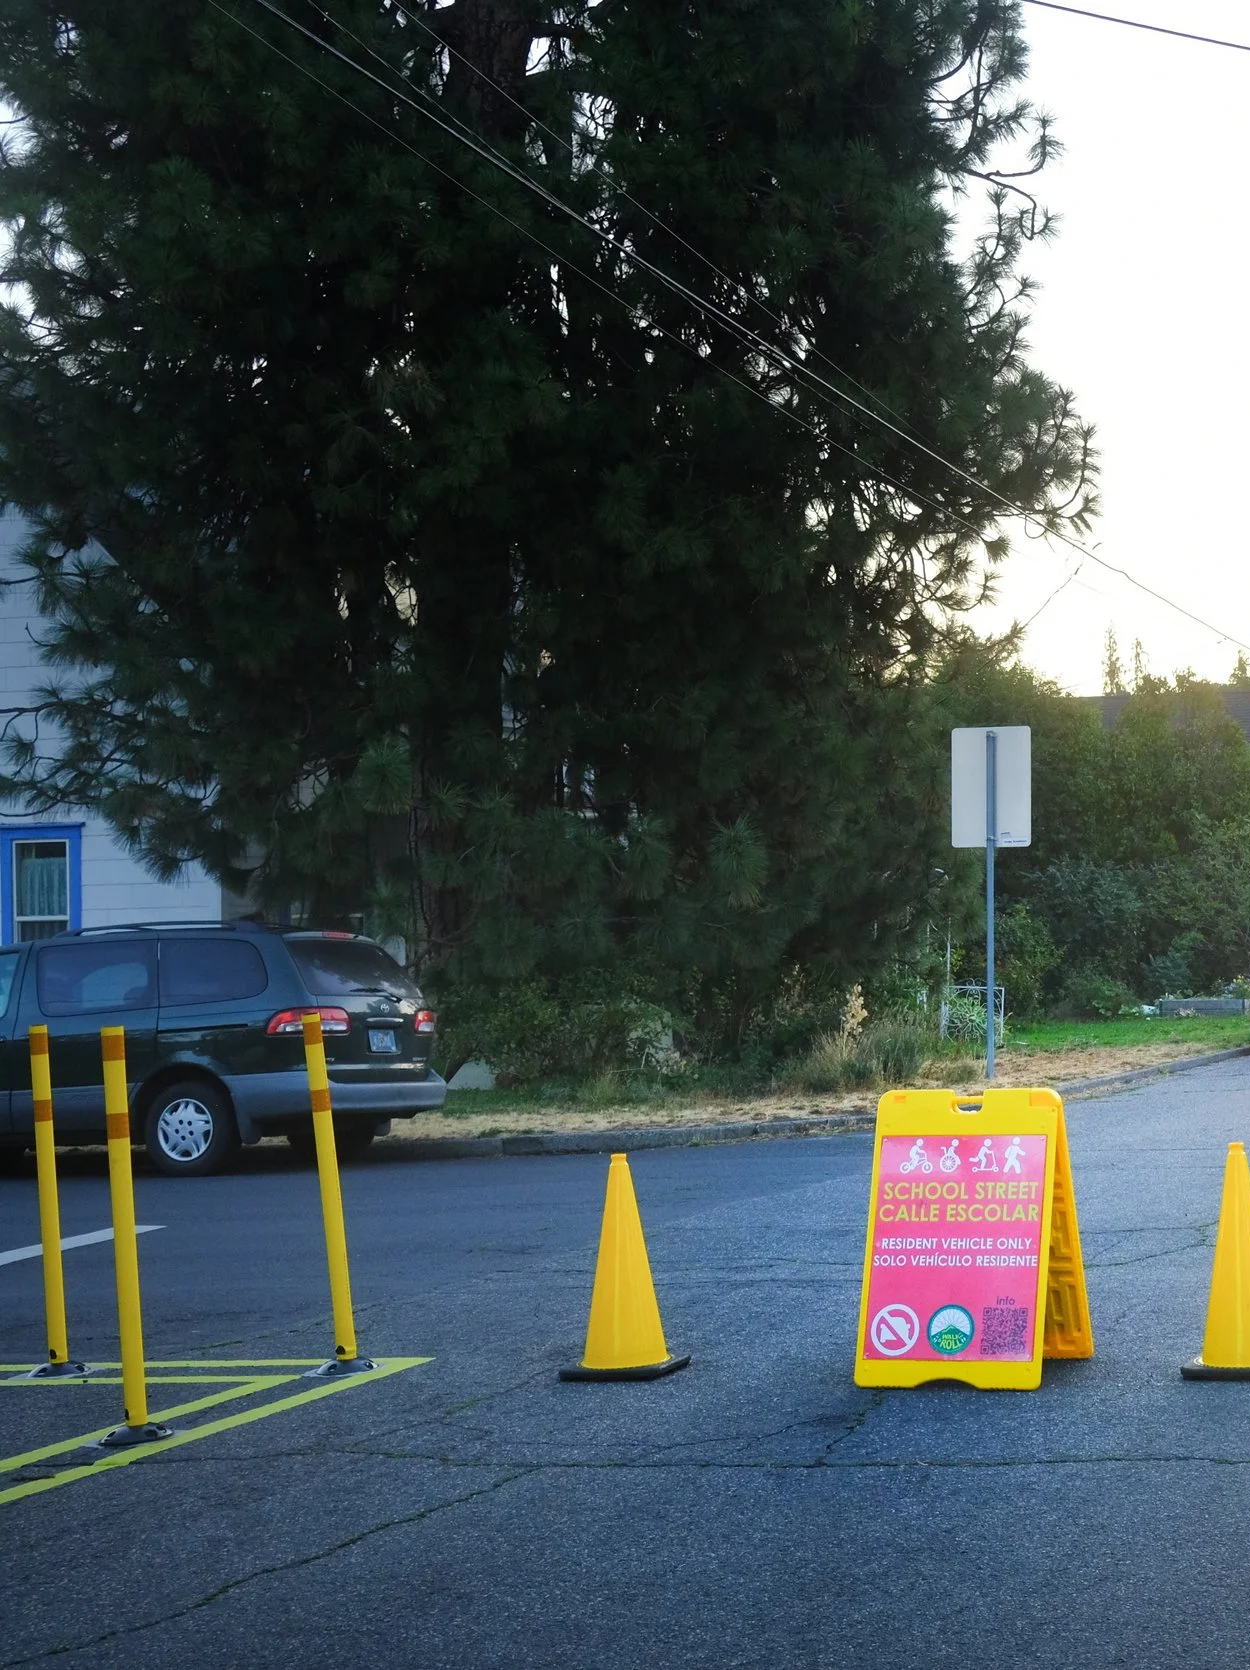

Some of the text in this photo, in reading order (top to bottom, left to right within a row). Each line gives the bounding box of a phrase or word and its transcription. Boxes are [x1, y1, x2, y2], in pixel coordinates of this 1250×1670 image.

[883, 1182, 1039, 1200] SCHOOL STREET
[879, 1204, 1039, 1222] CALLE ESCOLAR
[881, 1237, 1032, 1250] RESIDENT VEHICLE ONLY
[873, 1252, 1038, 1267] SOLO VEHÍCULO RESIDENTE
[939, 1339, 963, 1350] ROLL
